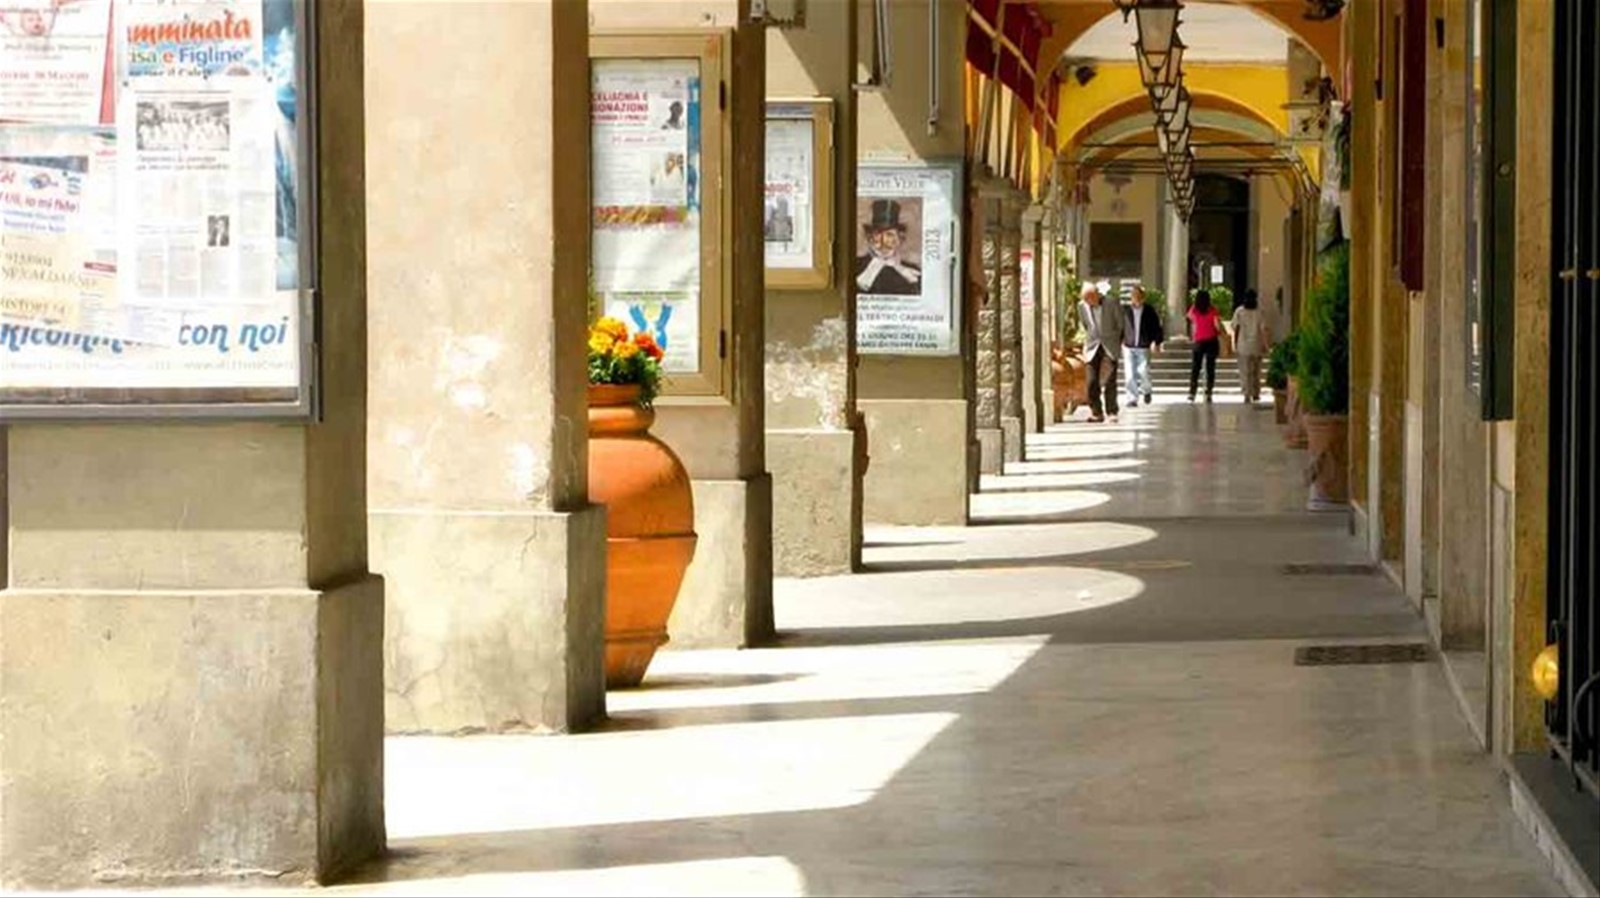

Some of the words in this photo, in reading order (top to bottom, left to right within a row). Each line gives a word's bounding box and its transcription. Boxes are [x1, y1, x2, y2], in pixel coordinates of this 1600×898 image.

[162, 51, 175, 63] e
[178, 323, 230, 353] con
[238, 315, 290, 353] noi
